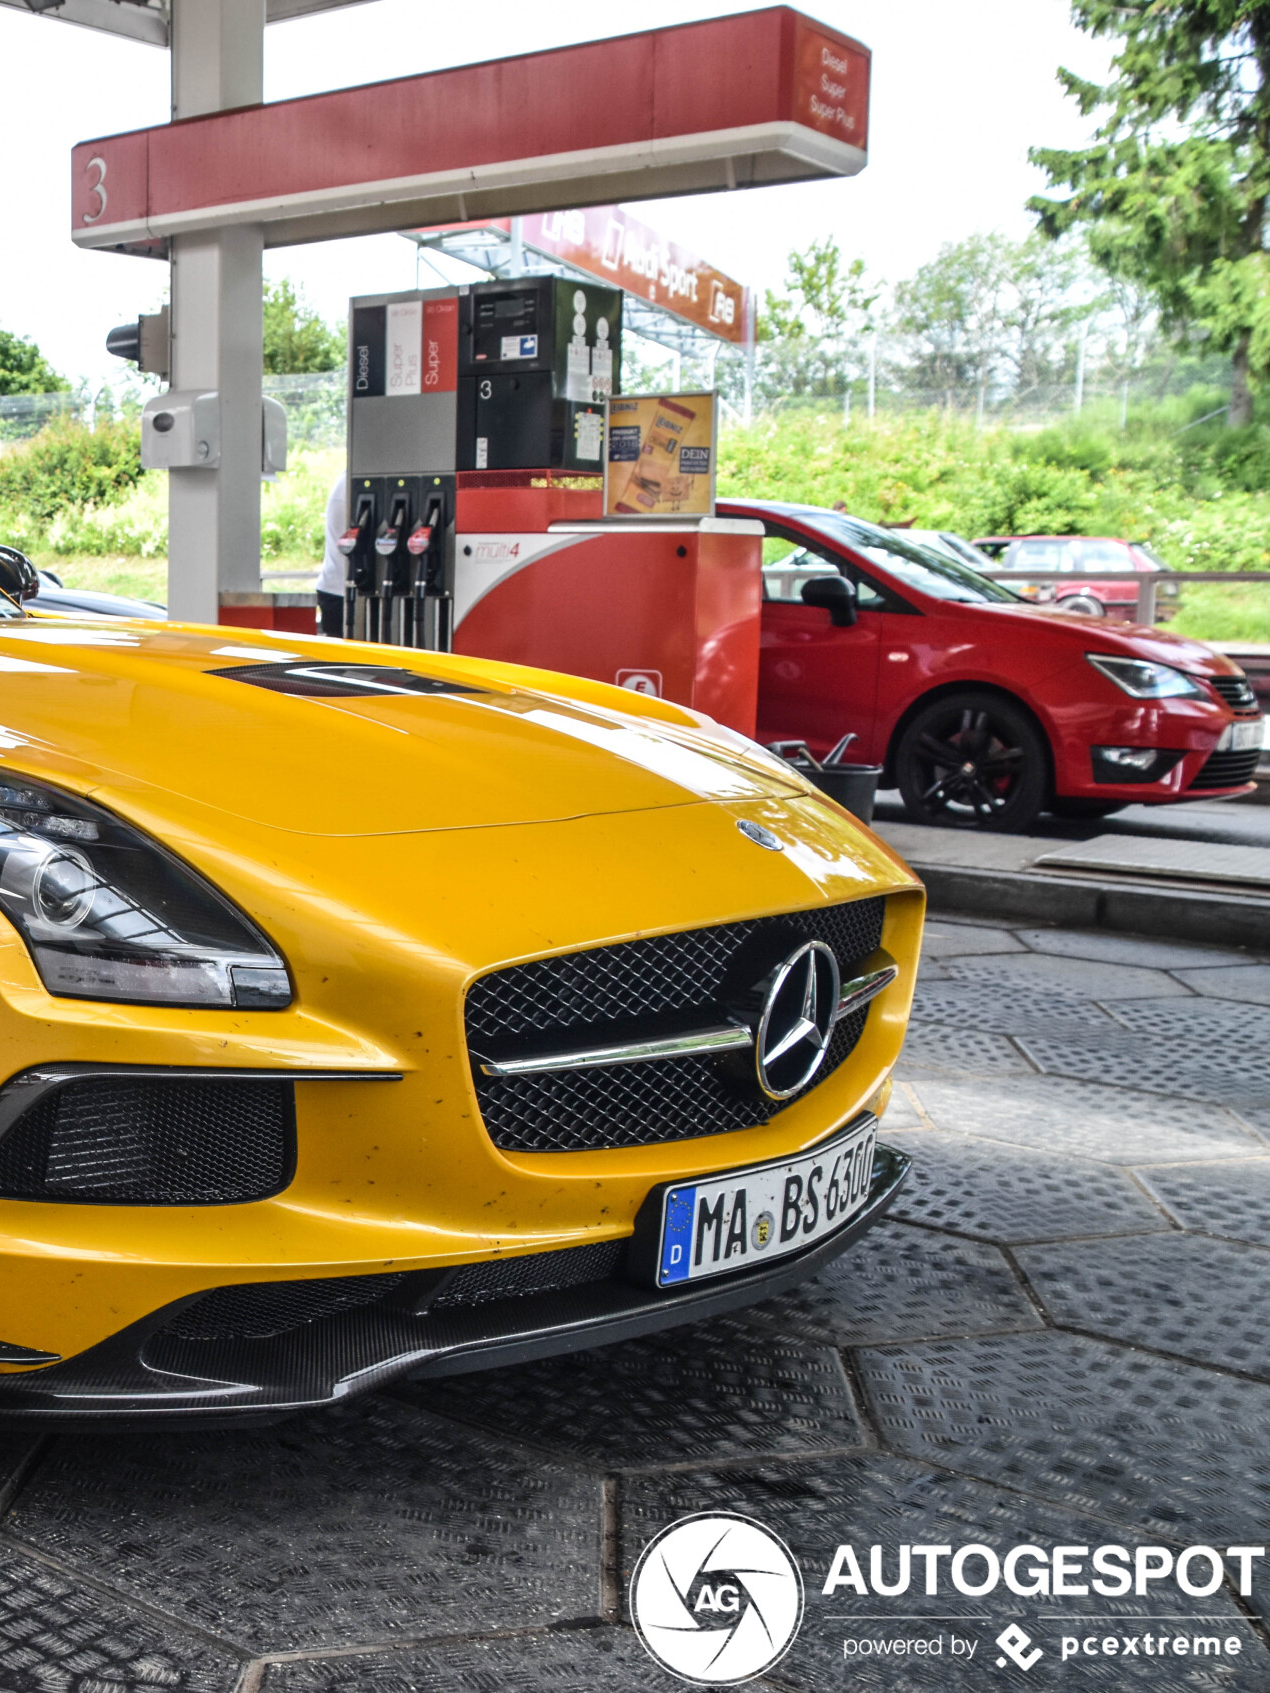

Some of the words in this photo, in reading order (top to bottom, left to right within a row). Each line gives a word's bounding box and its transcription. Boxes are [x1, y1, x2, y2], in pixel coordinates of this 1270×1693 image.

[821, 47, 848, 74] Diesel
[821, 73, 846, 99] Super
[811, 94, 835, 119] Super
[836, 106, 855, 130] Plus
[83, 157, 107, 223] 3
[659, 241, 698, 302] Sport
[356, 345, 369, 390] Diesel
[390, 343, 403, 387] Super
[405, 354, 417, 386] Plus
[425, 339, 440, 385] Super
[481, 380, 492, 399] 3
[681, 449, 709, 459] DEIN
[695, 1188, 747, 1266] MA
[780, 1166, 823, 1242] BS
[827, 1134, 874, 1221] 6300
[670, 1245, 682, 1264] D
